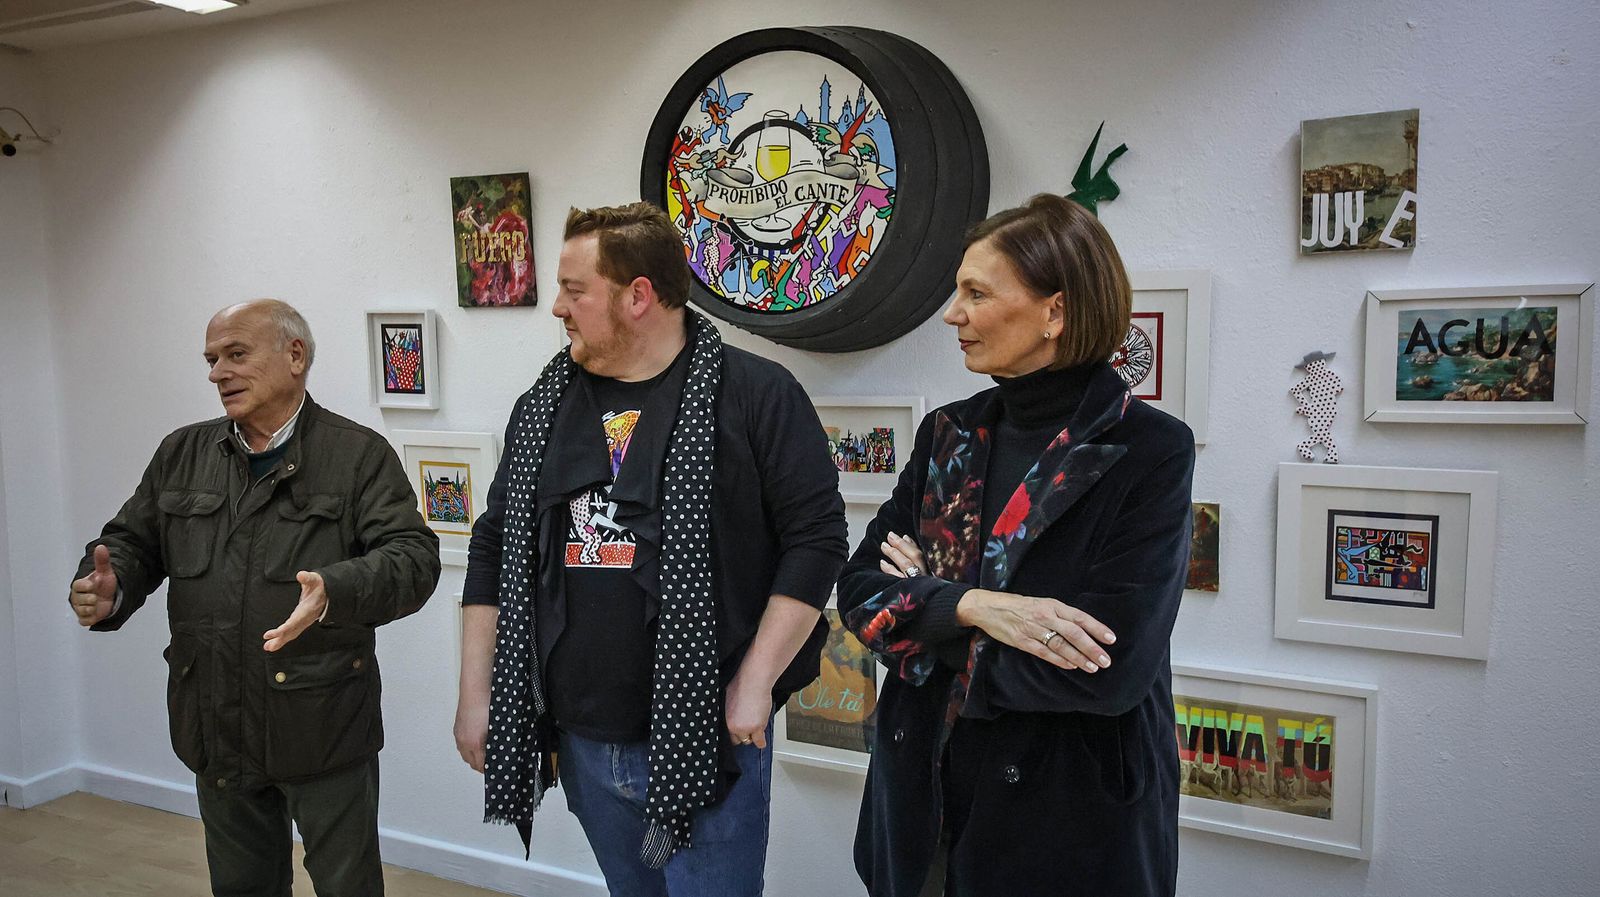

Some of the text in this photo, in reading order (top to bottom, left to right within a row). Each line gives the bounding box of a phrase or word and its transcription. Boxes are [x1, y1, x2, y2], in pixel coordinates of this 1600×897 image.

[709, 179, 849, 210] PROHIBIDO EL CANTE
[460, 230, 526, 263] FUEGO
[1404, 314, 1551, 360] AGUA
[1175, 703, 1332, 783] VIVA TÚ
